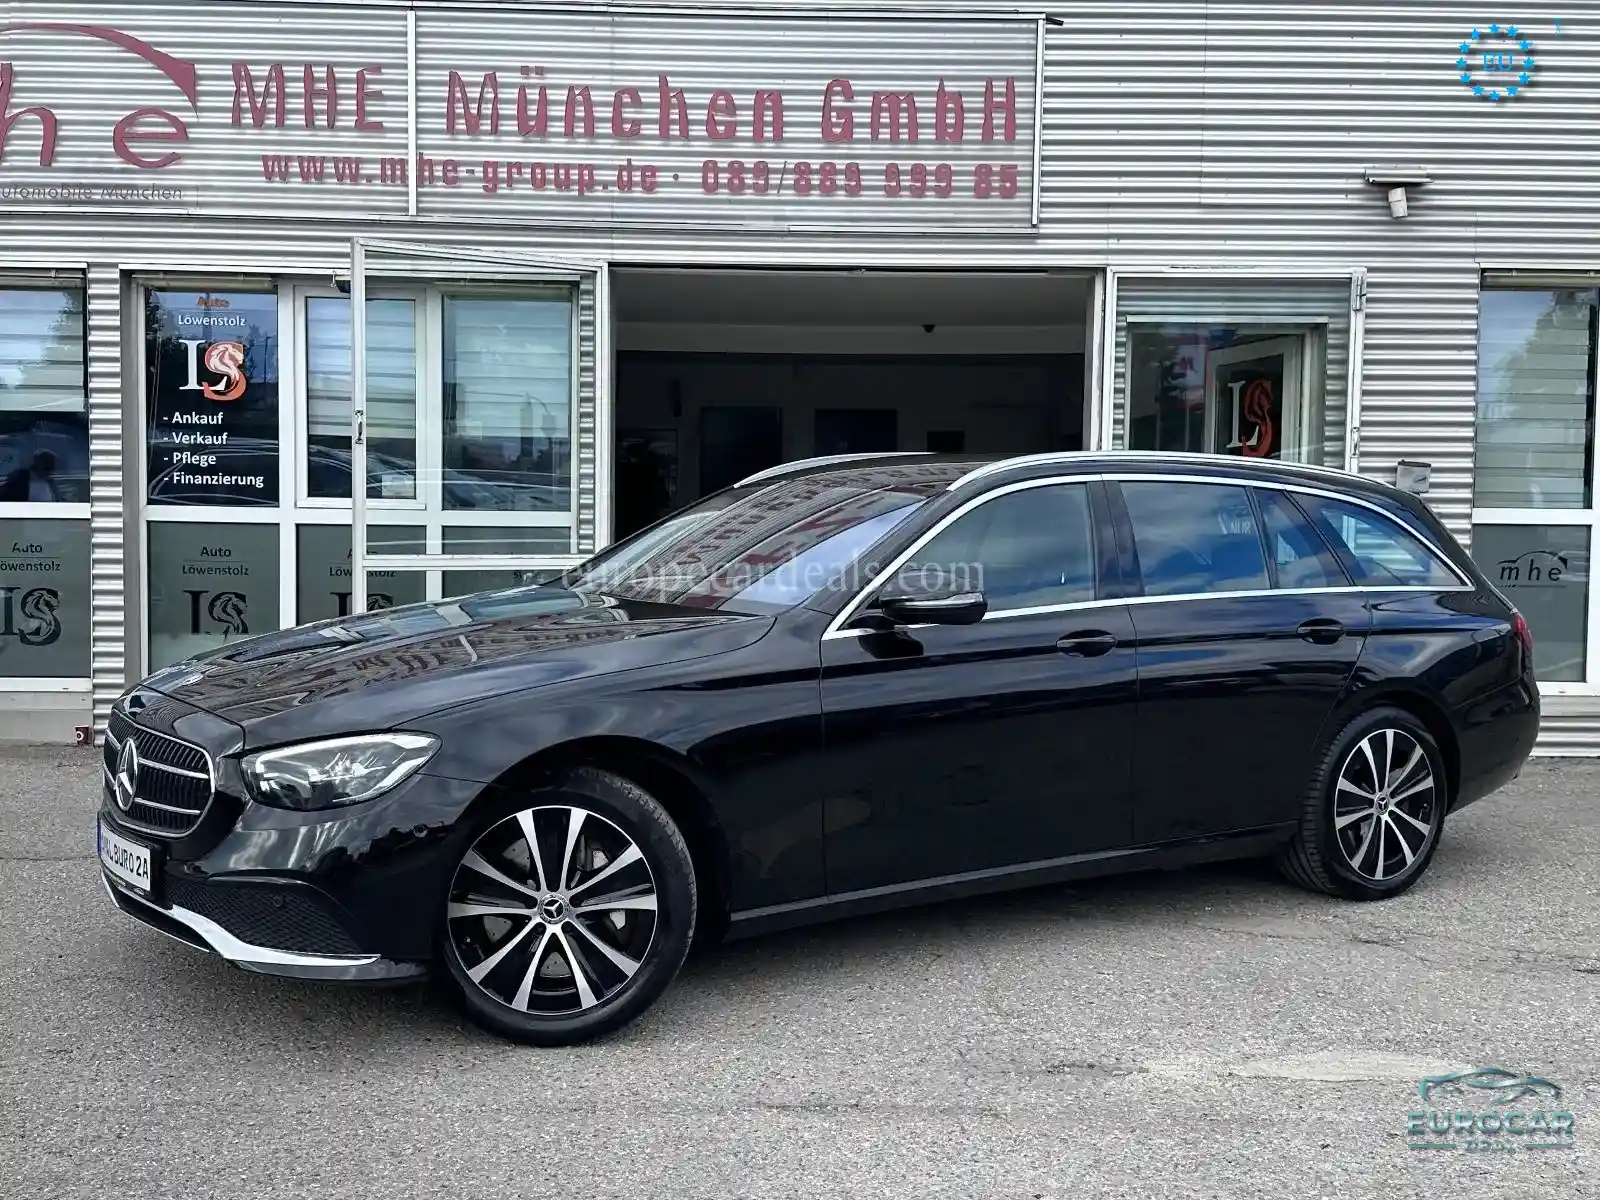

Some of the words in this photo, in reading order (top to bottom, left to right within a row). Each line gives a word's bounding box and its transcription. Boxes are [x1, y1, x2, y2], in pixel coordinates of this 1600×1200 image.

[231, 62, 384, 130] MHE
[445, 65, 785, 143] München
[820, 77, 1017, 143] GmbH
[261, 152, 658, 197] www.mhe-group.de
[701, 159, 862, 196] 089/889
[883, 162, 954, 199] 999
[973, 163, 1019, 199] 85
[178, 314, 246, 326] Löwenstolz
[178, 339, 247, 401] LS
[172, 411, 224, 425] Ankauf
[172, 432, 228, 445] Verkauf
[173, 452, 217, 467] Pflege
[173, 472, 265, 489] Finanzierung
[12, 543, 43, 554] Auto
[200, 546, 232, 558] Auto
[1500, 559, 1562, 581] mhe
[136, 855, 149, 880] 2A
